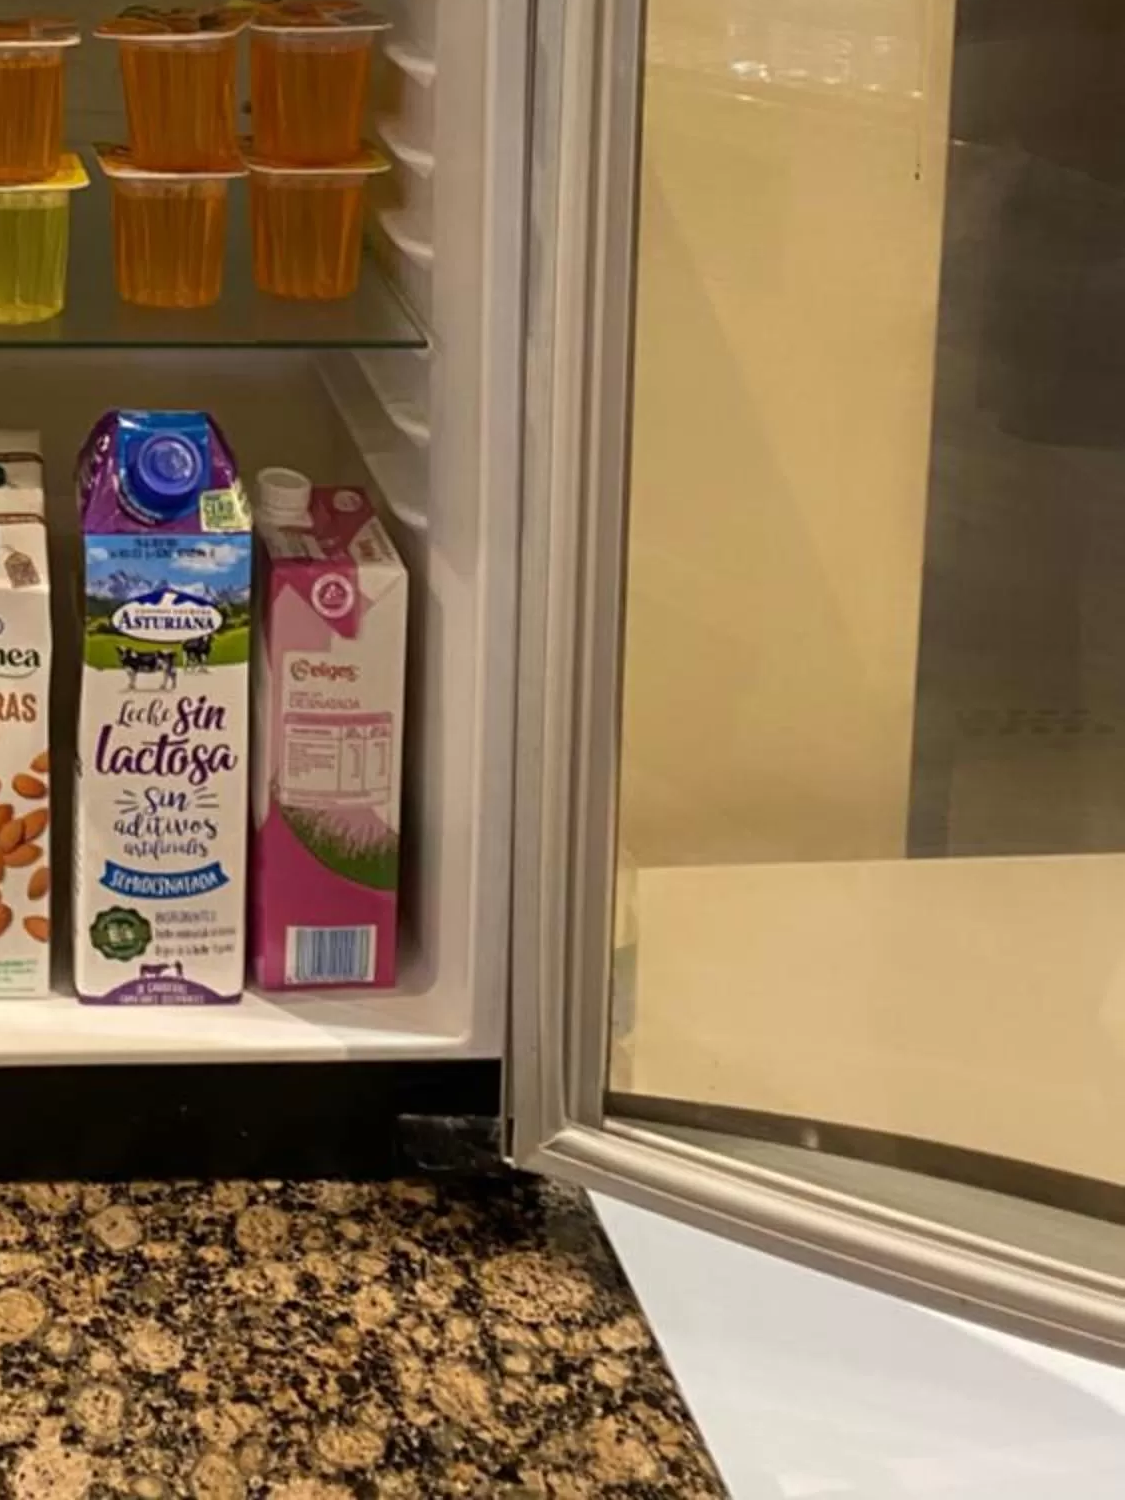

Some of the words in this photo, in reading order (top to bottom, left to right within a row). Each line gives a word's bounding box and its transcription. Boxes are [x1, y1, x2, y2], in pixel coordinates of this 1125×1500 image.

[119, 610, 215, 631] ASTURIANA
[95, 724, 238, 786] lactosa
[114, 813, 218, 840] aditivos
